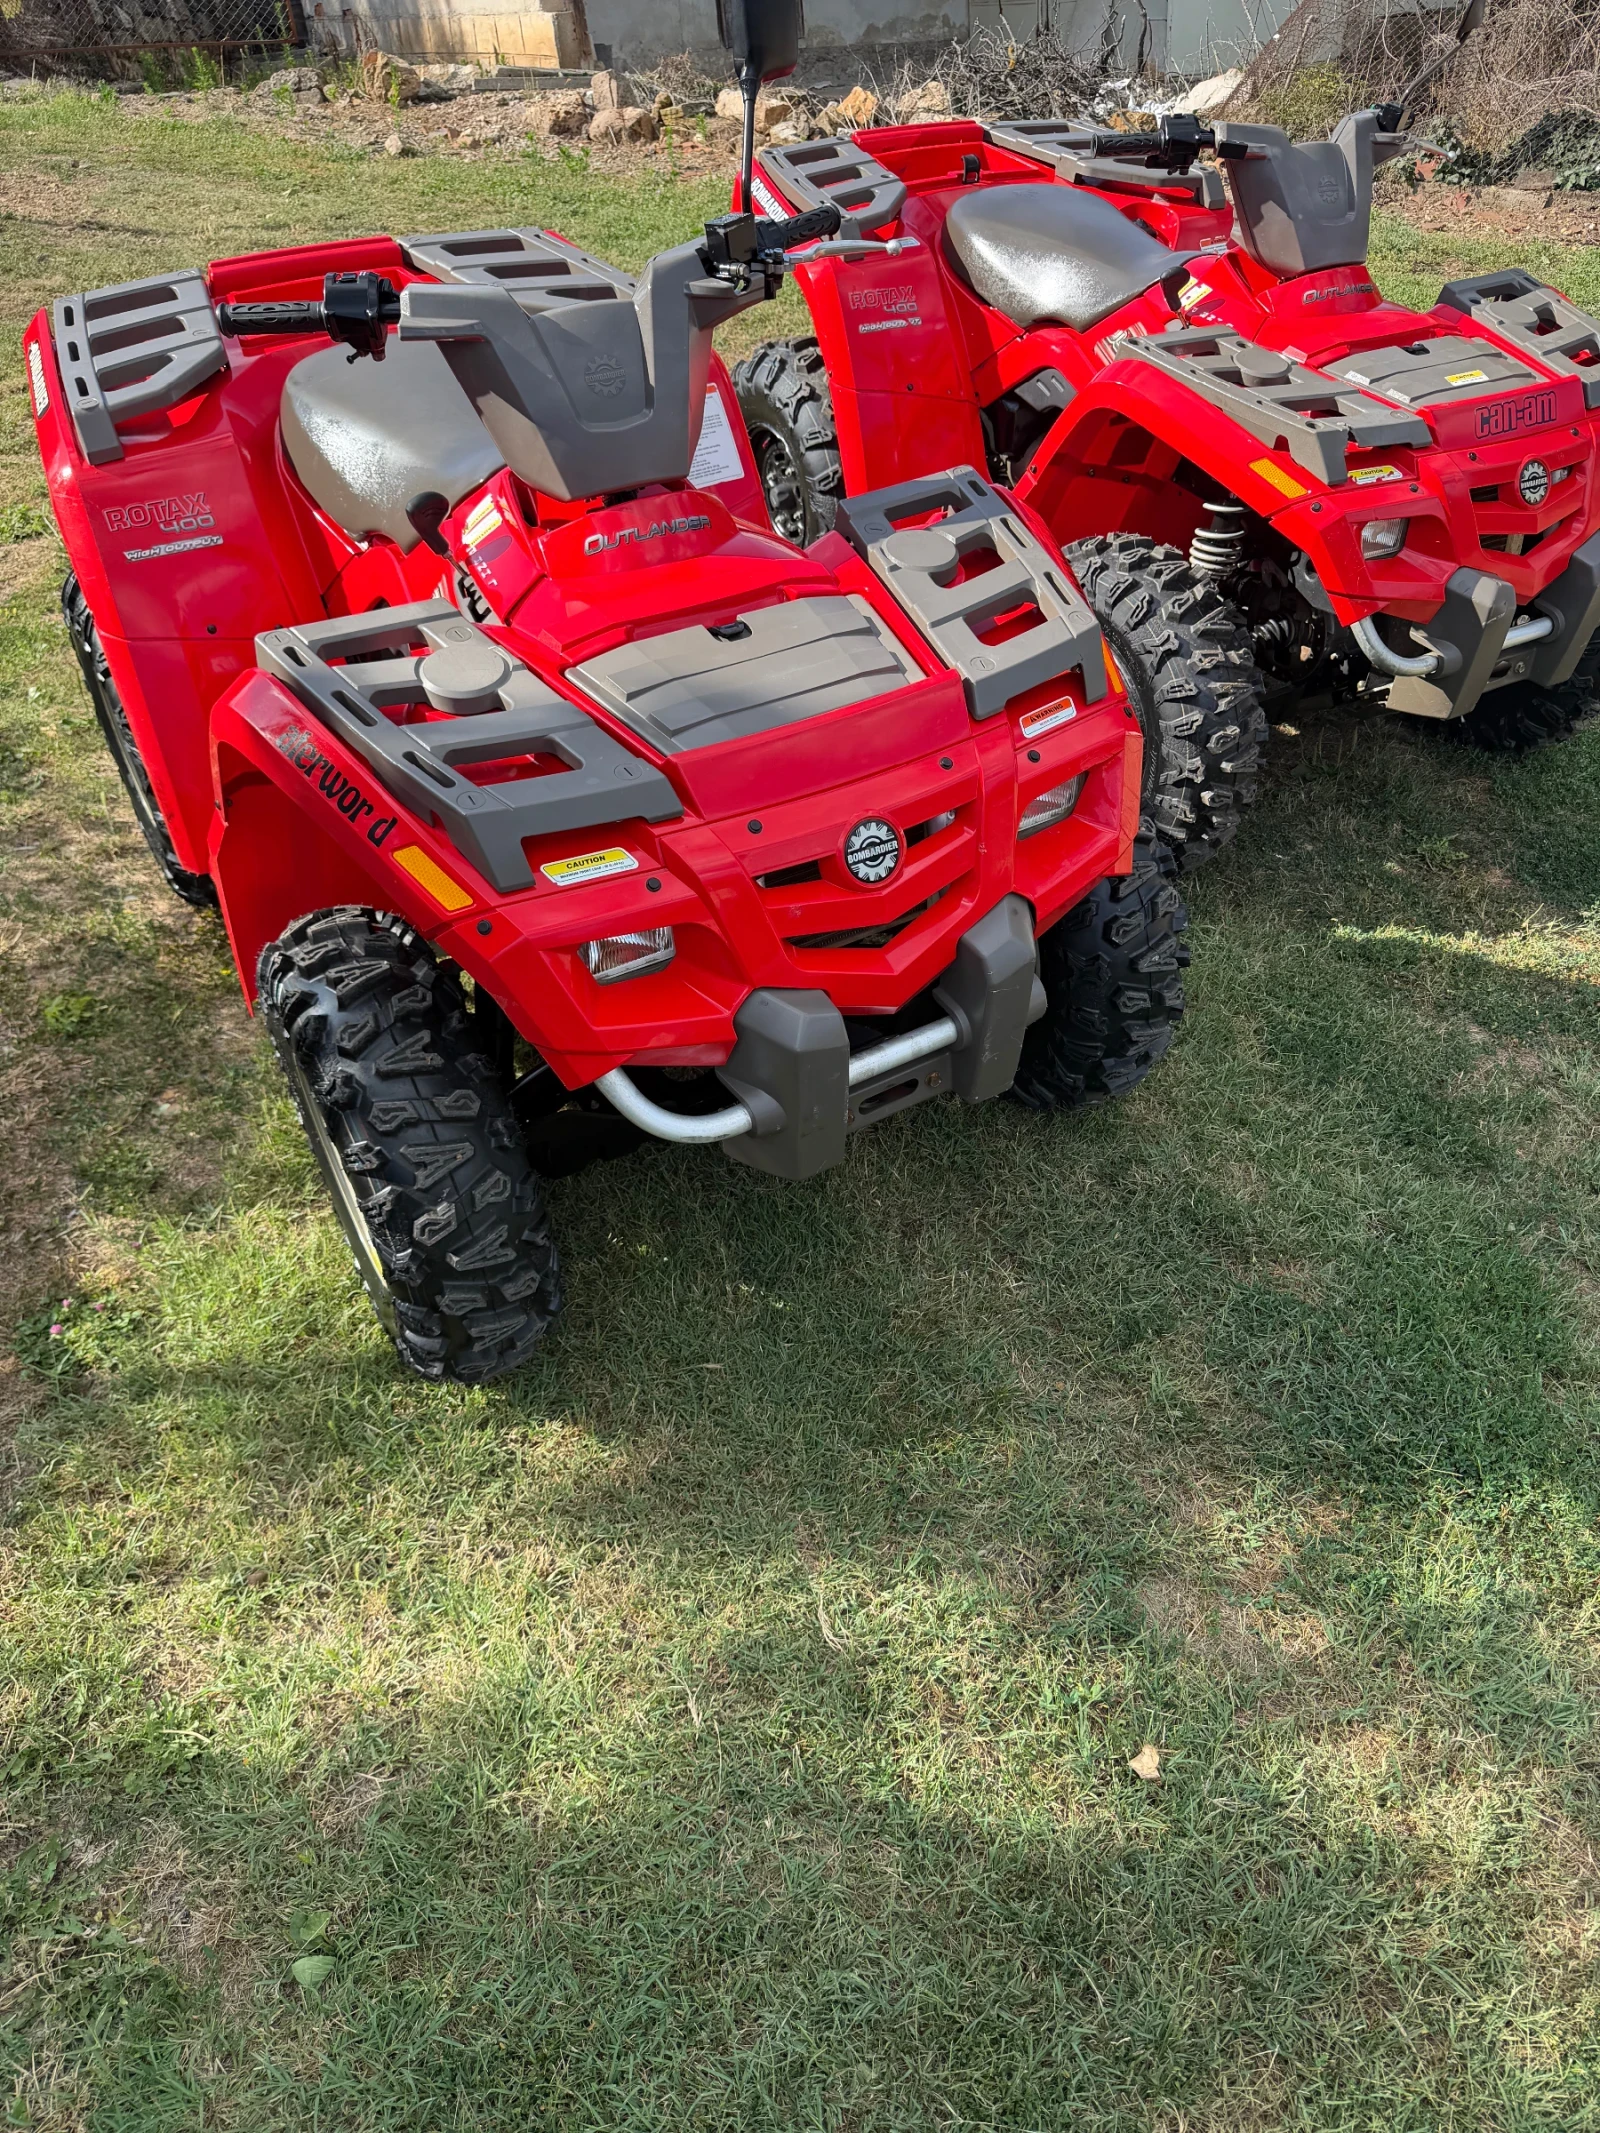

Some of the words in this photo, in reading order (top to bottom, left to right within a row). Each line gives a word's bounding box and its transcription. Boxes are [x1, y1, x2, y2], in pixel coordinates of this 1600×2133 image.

[848, 286, 916, 310] ROTAX
[883, 302, 918, 313] 400
[102, 492, 211, 532] ROTAX
[159, 514, 216, 533] 400
[584, 515, 712, 555] OUTLANDER
[127, 547, 162, 561] HIGH
[165, 535, 221, 552] OUTPUT
[1036, 703, 1064, 719] WARNING
[566, 855, 606, 869] CAUTION
[847, 840, 899, 864] BOMBARDIER
